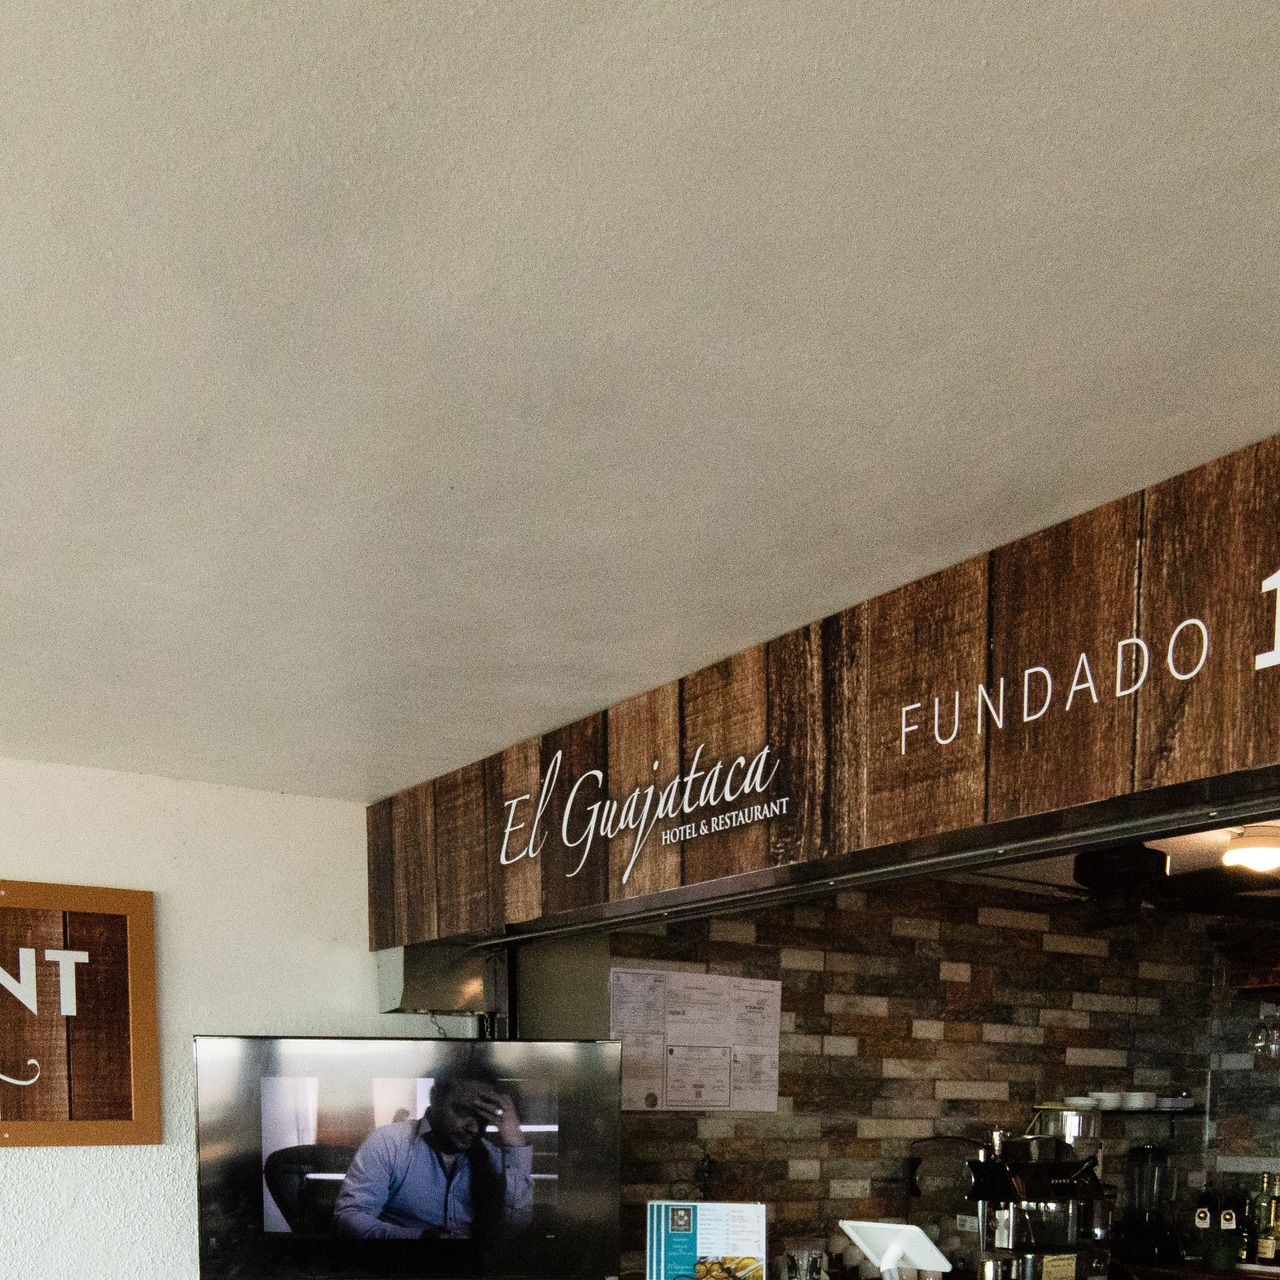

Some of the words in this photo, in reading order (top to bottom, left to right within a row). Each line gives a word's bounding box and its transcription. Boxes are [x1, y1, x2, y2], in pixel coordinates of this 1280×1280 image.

[901, 618, 1208, 755] FUNDADO
[500, 749, 563, 865] El
[561, 743, 781, 884] Guajataca
[661, 822, 698, 846] HOTEL
[699, 820, 709, 835] &
[711, 797, 790, 832] RESTAURANT
